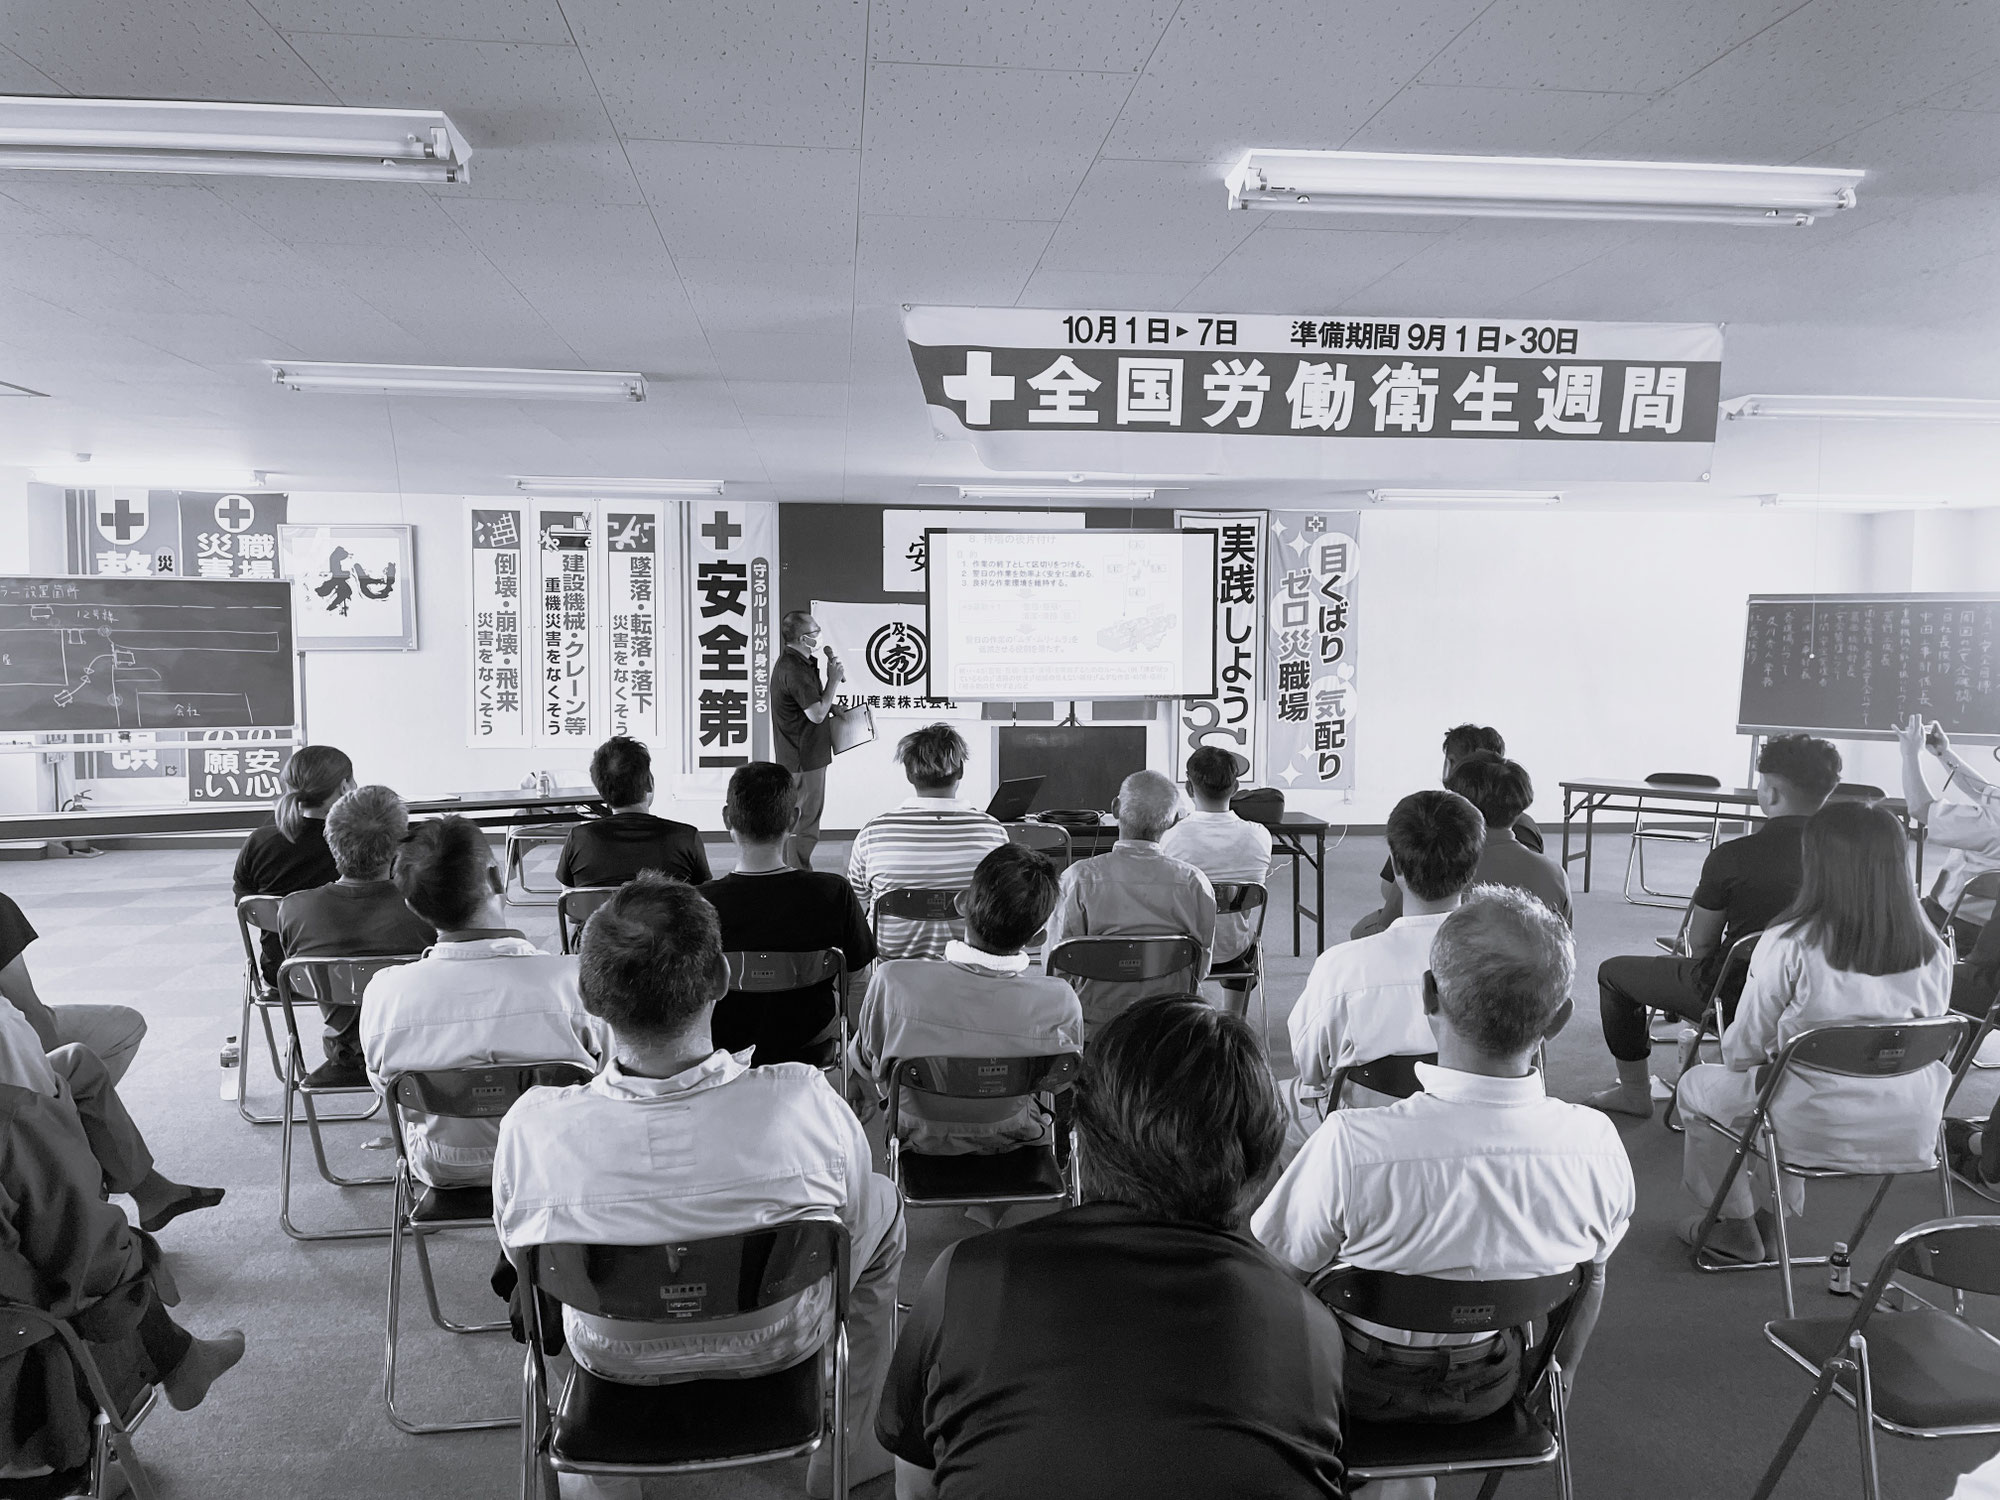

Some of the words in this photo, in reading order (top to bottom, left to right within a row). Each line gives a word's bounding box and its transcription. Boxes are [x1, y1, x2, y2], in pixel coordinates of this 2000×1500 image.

[1026, 353, 1688, 435] 全国労働衛生週間
[544, 576, 562, 736] 重機災害をなくそう
[697, 559, 749, 768] 安全第一
[752, 562, 769, 715] 守るルールが身を守る
[1219, 524, 1257, 724] 実践しよう
[1277, 568, 1312, 722] ゼロ災職場
[1319, 543, 1349, 664] 目くばり
[477, 611, 494, 736] 災害をなくそう
[612, 614, 629, 737] 災害をなくそう
[1314, 688, 1347, 781] 気配り
